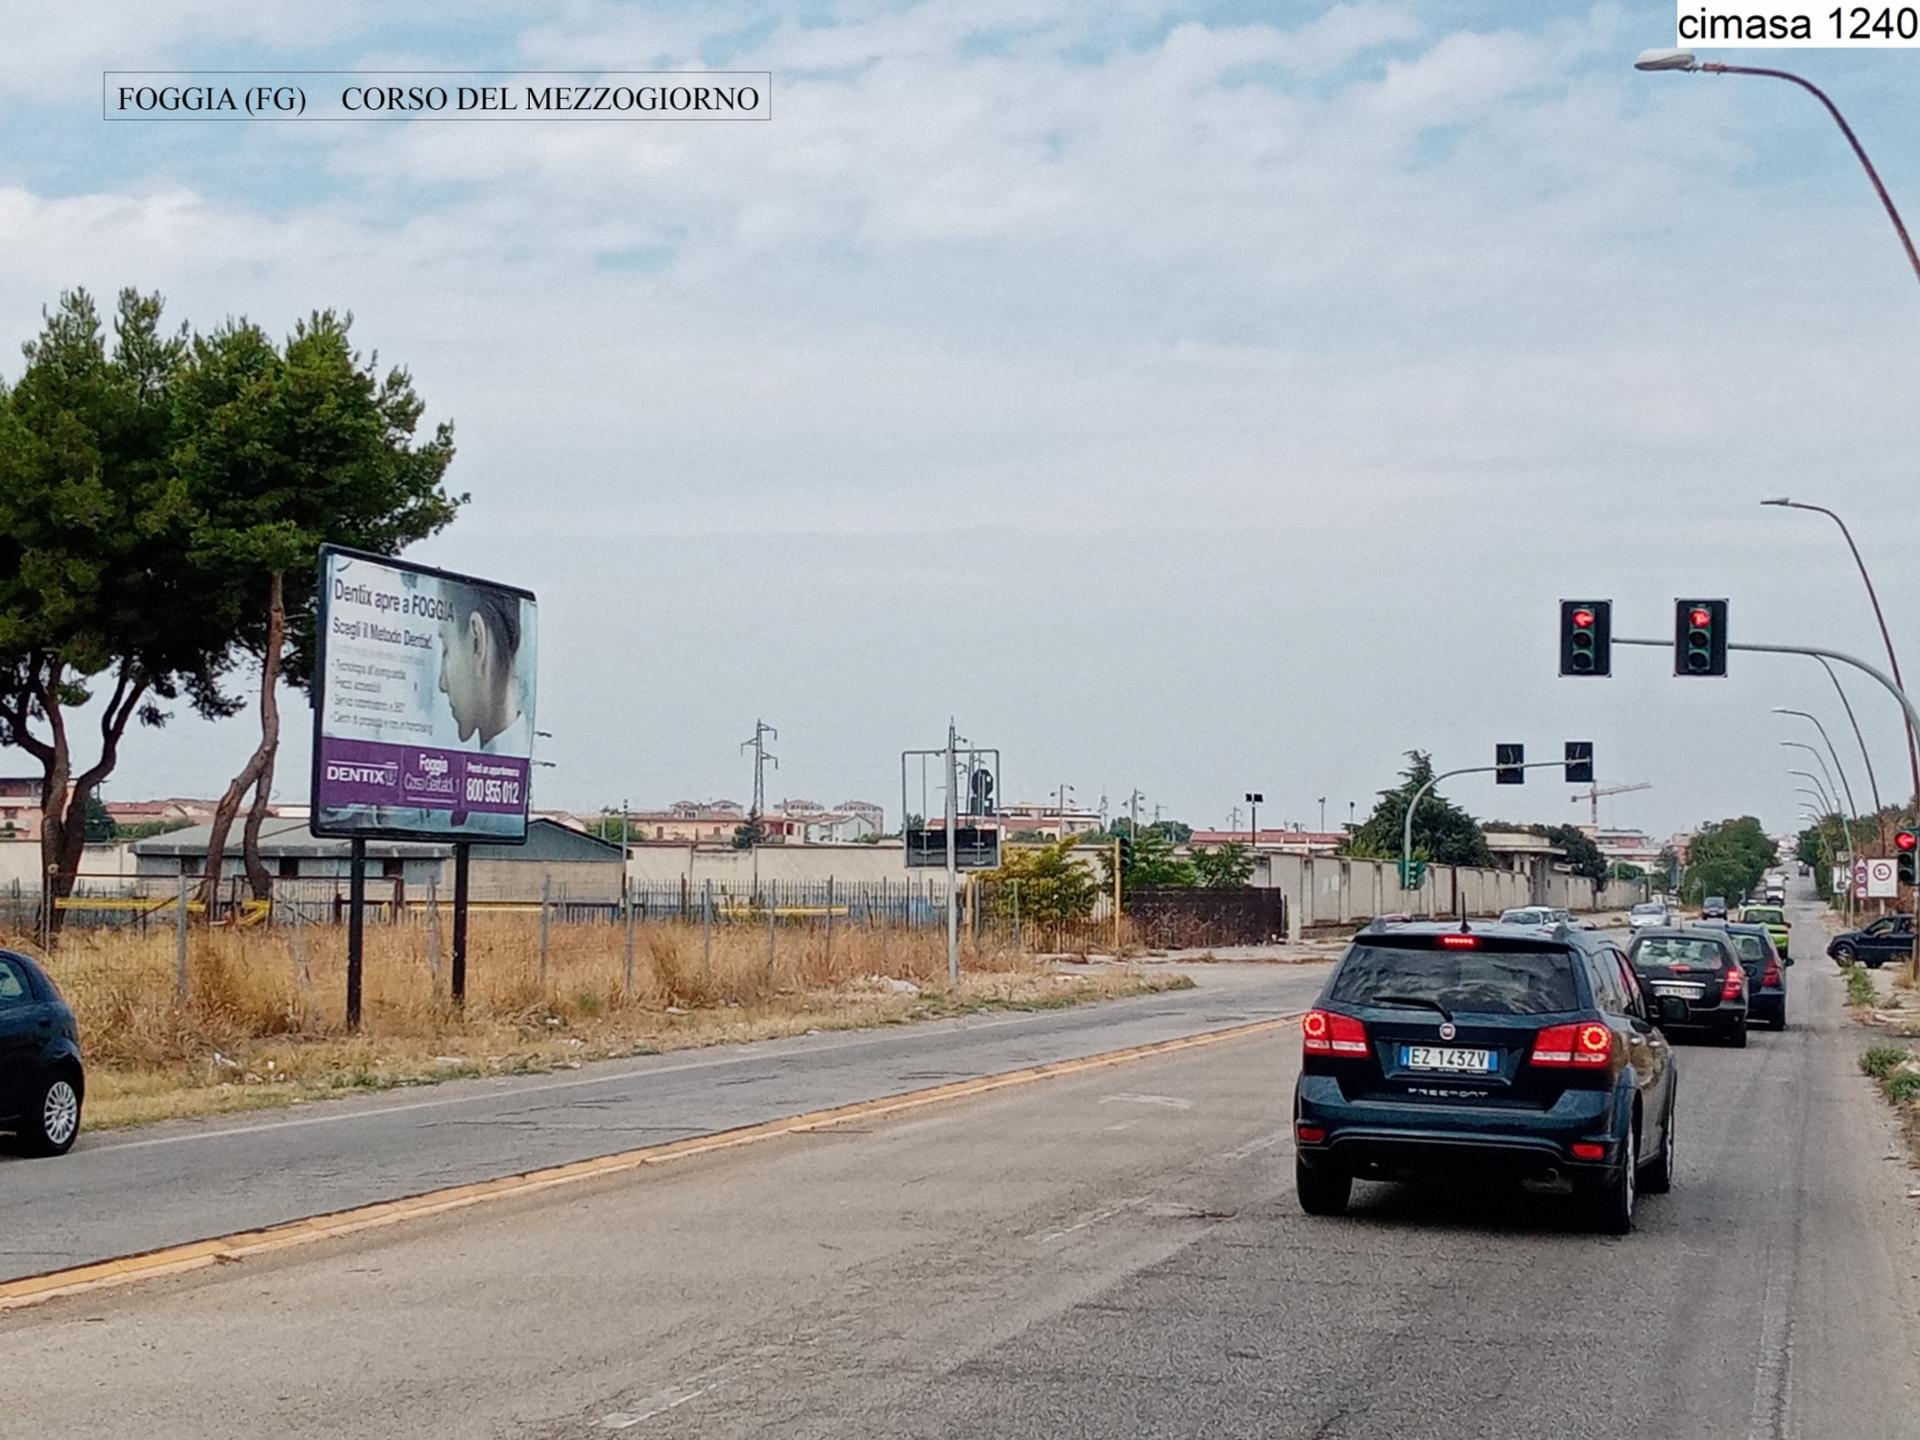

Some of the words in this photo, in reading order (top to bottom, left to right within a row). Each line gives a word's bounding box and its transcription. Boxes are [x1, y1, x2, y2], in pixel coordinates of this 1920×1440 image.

[335, 578, 372, 607] Dentix
[374, 592, 401, 614] apre
[402, 597, 410, 614] a
[411, 594, 455, 623] FOGGIA
[326, 766, 386, 786] DENTIX
[466, 778, 485, 803] 800
[502, 780, 520, 805] 012
[1411, 1048, 1432, 1066] EZ
